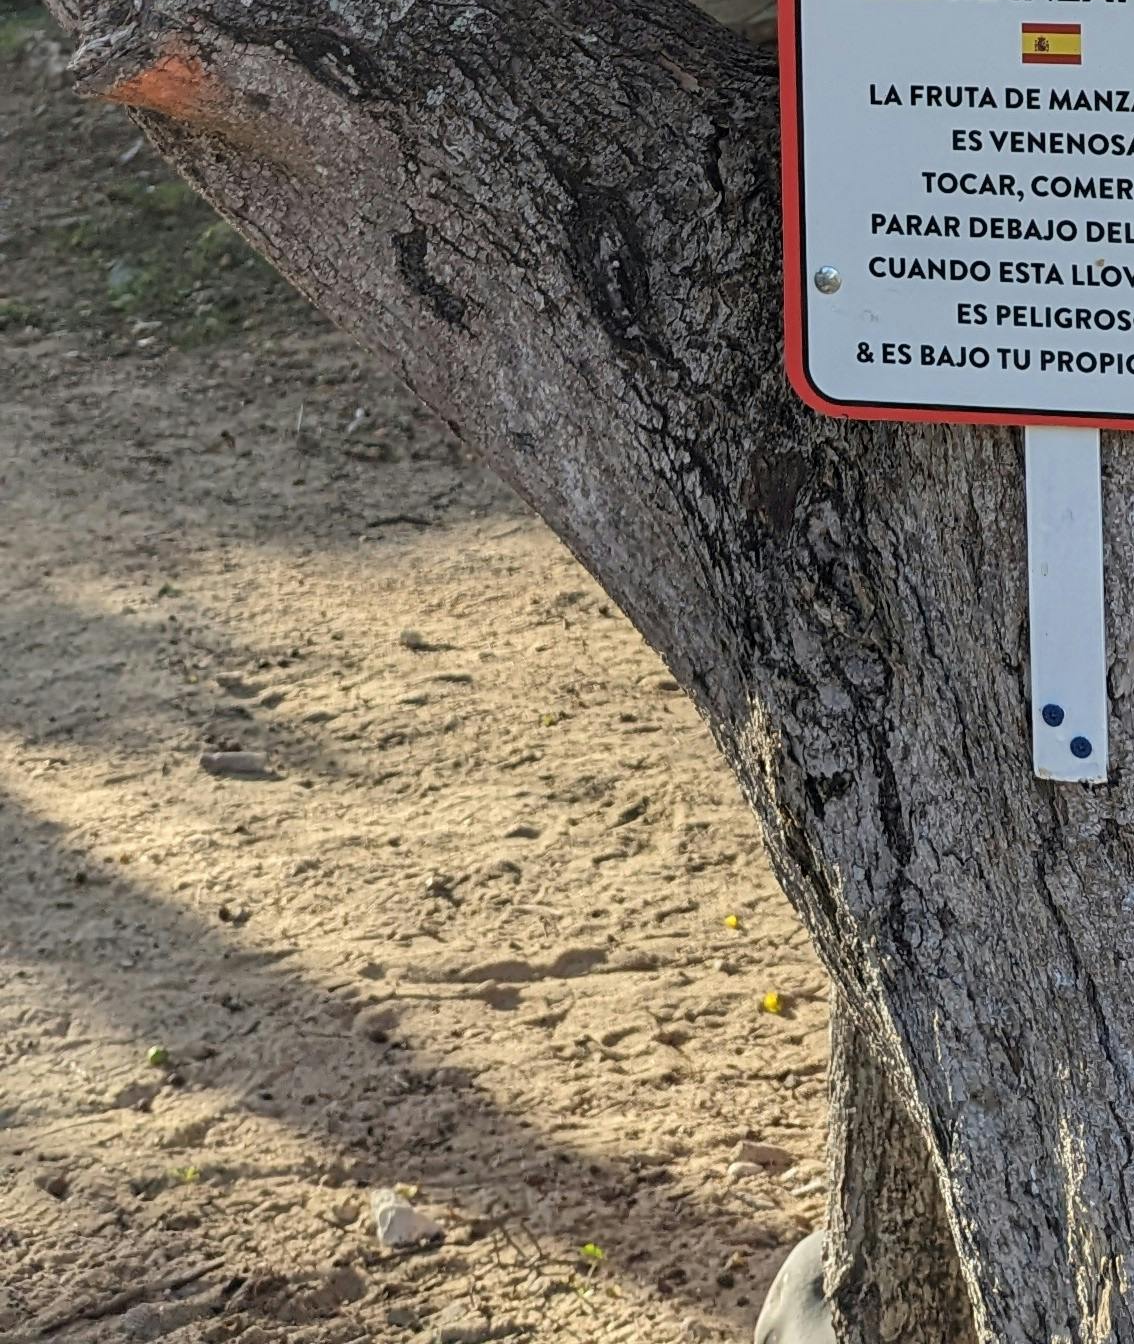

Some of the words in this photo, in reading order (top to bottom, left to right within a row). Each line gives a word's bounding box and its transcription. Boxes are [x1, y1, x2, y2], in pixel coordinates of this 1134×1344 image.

[869, 83, 903, 106] LA
[910, 84, 998, 109] FRUTA
[1005, 87, 1041, 110] DE
[952, 129, 983, 152] ES
[921, 171, 1025, 202] TOCAR,
[1030, 175, 1134, 200] COMER
[871, 213, 961, 238] PARAR
[969, 216, 1078, 242] DEBAJO
[868, 256, 991, 282] CUANDO
[999, 261, 1065, 286] ESTA
[957, 302, 988, 326] ES
[856, 341, 875, 364] &
[881, 342, 912, 365] ES
[920, 344, 990, 369] BAJO
[996, 347, 1031, 371] TU
